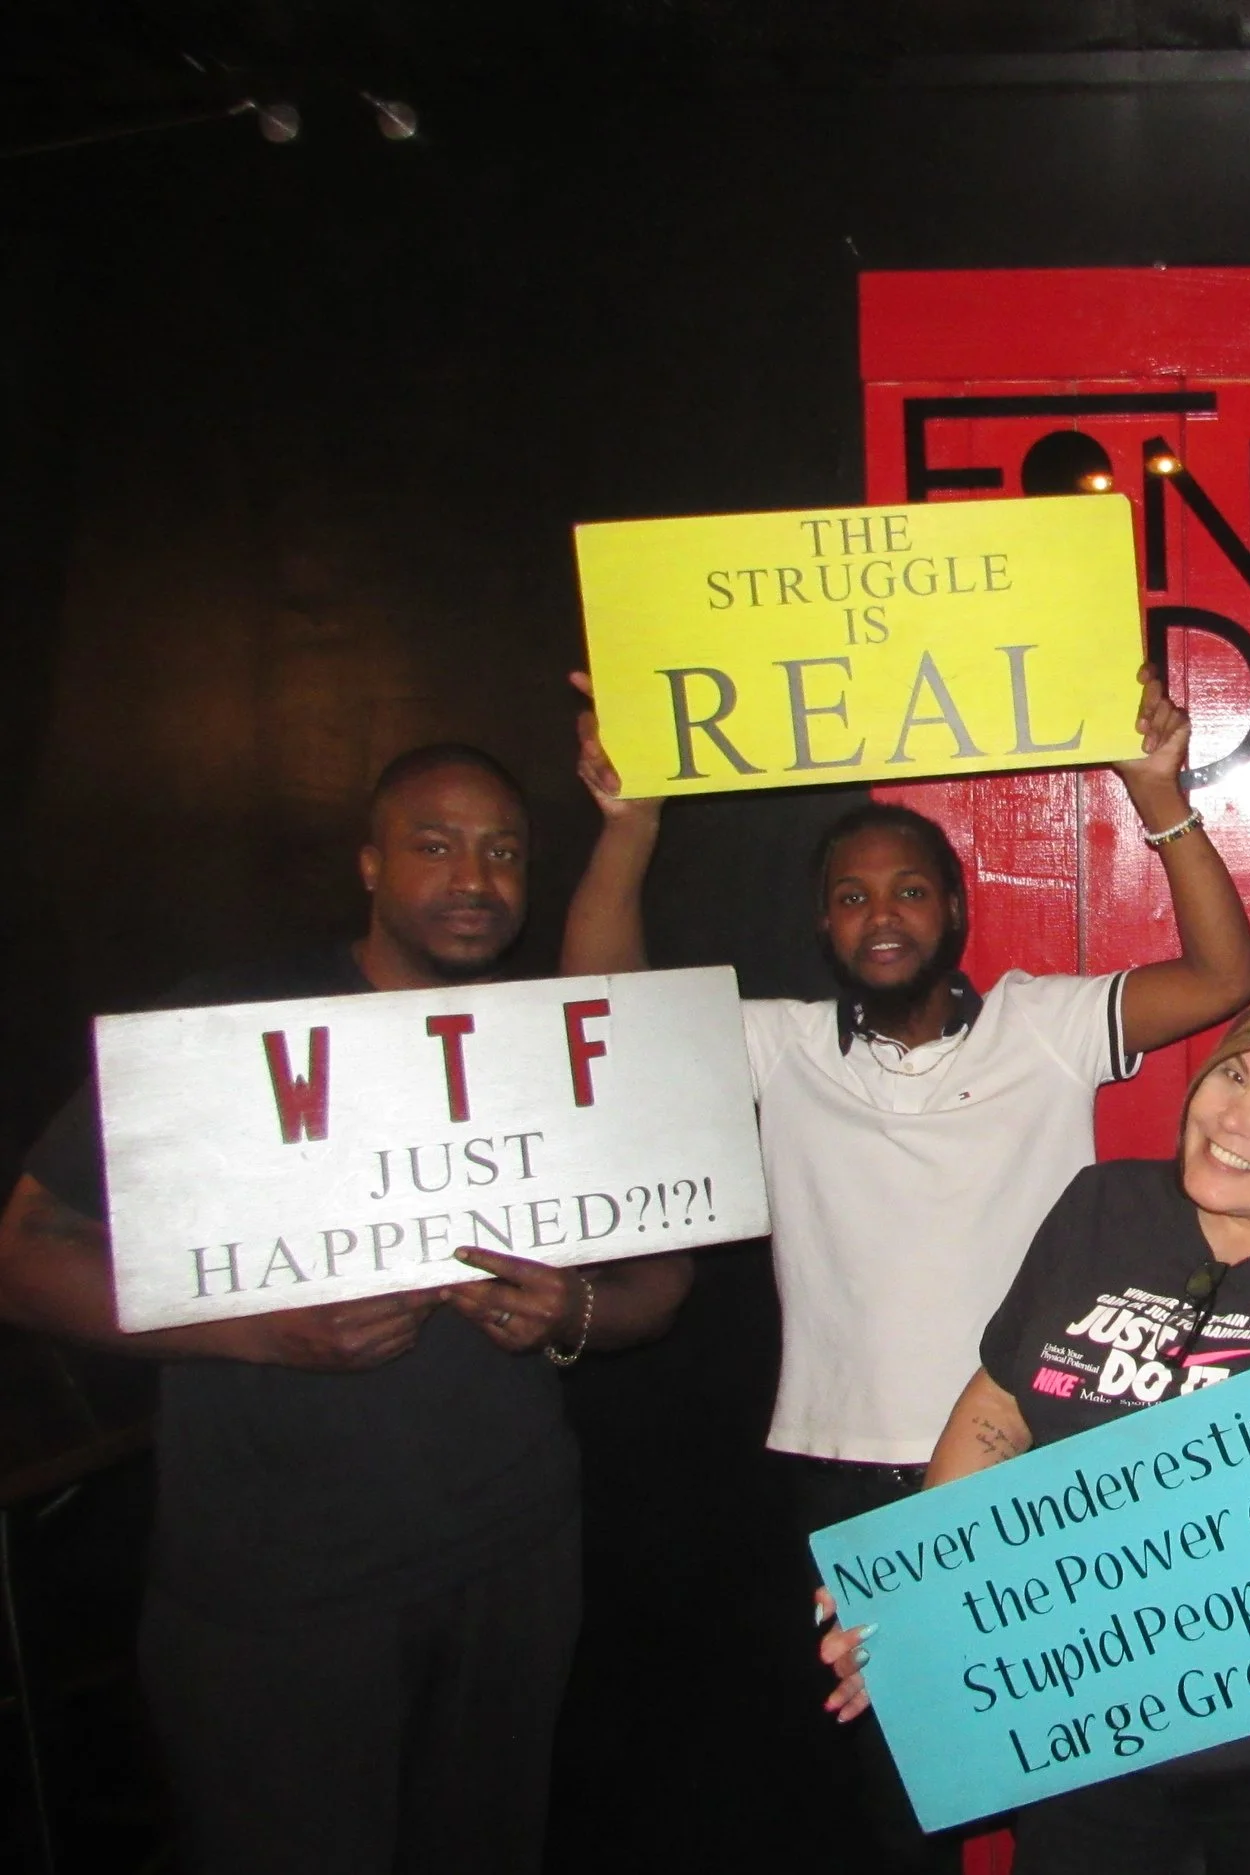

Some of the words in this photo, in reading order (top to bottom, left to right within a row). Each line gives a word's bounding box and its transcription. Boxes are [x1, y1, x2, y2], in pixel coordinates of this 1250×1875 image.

[801, 514, 913, 558] THE
[706, 553, 1014, 612] STRUGGLE
[845, 606, 890, 646] IS
[654, 644, 1085, 782] REAL
[370, 1131, 545, 1200] JUST
[1123, 1287, 1180, 1310] WHETHER
[1065, 1304, 1179, 1361] JUST
[1032, 1367, 1080, 1398] NIKE
[1097, 1348, 1173, 1402] DO
[834, 1522, 981, 1606] Never
[963, 1577, 1051, 1635] the
[1054, 1506, 1231, 1605] Power
[962, 1610, 1136, 1714] Stupid
[1008, 1692, 1171, 1775] Large
